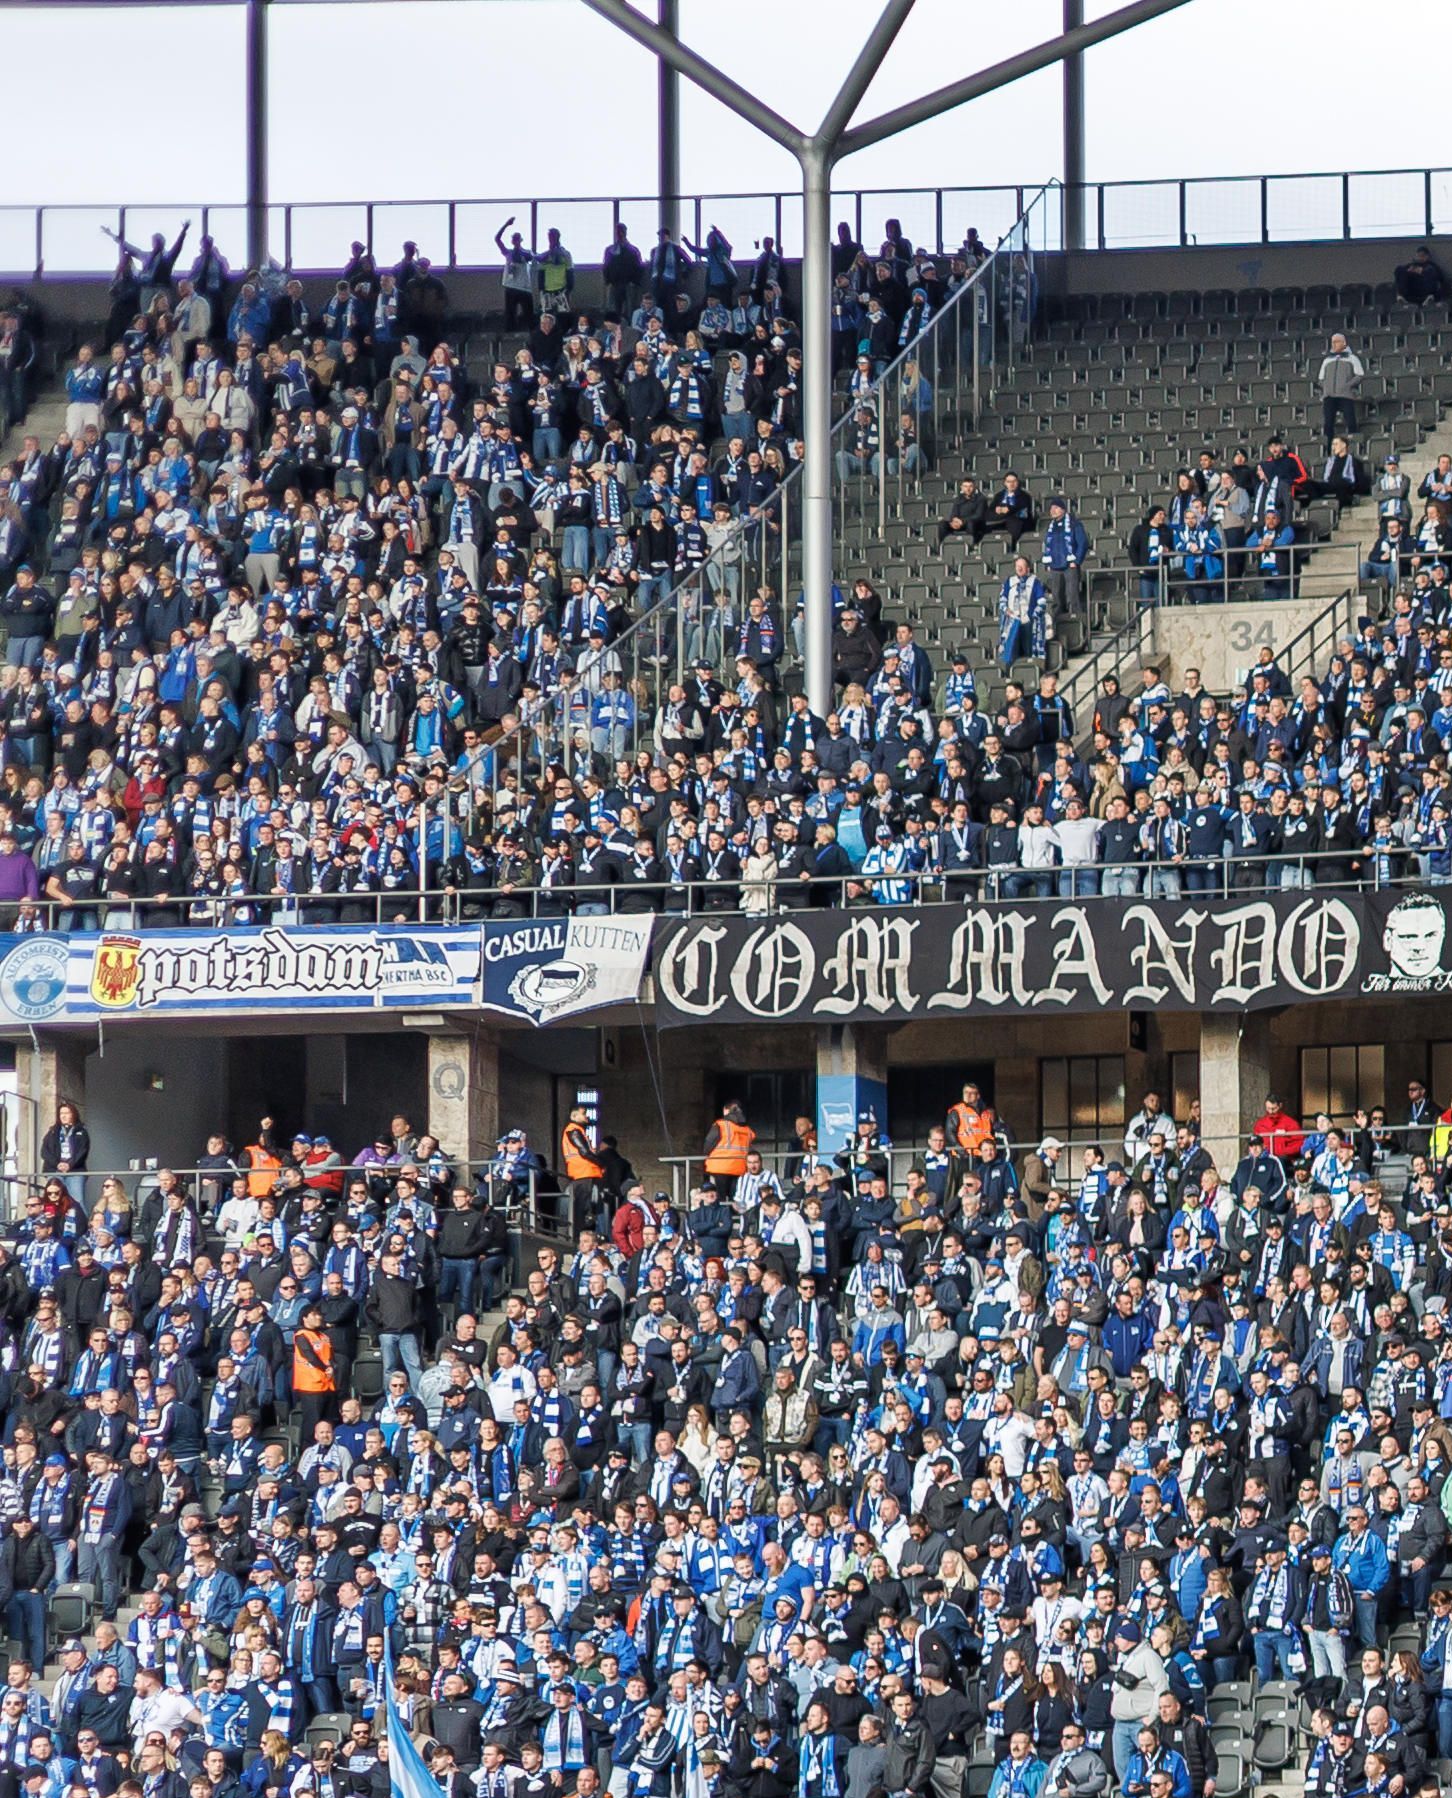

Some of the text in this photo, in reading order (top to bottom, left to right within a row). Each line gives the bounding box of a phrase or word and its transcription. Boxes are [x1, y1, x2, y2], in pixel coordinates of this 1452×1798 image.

[1229, 620, 1280, 653] 34
[484, 924, 646, 962] CASUAL KUTTEN
[658, 898, 1361, 1016] COMMANDO
[136, 929, 384, 1006] potsdam
[426, 968, 447, 982] BSC
[433, 1062, 466, 1102] Q
